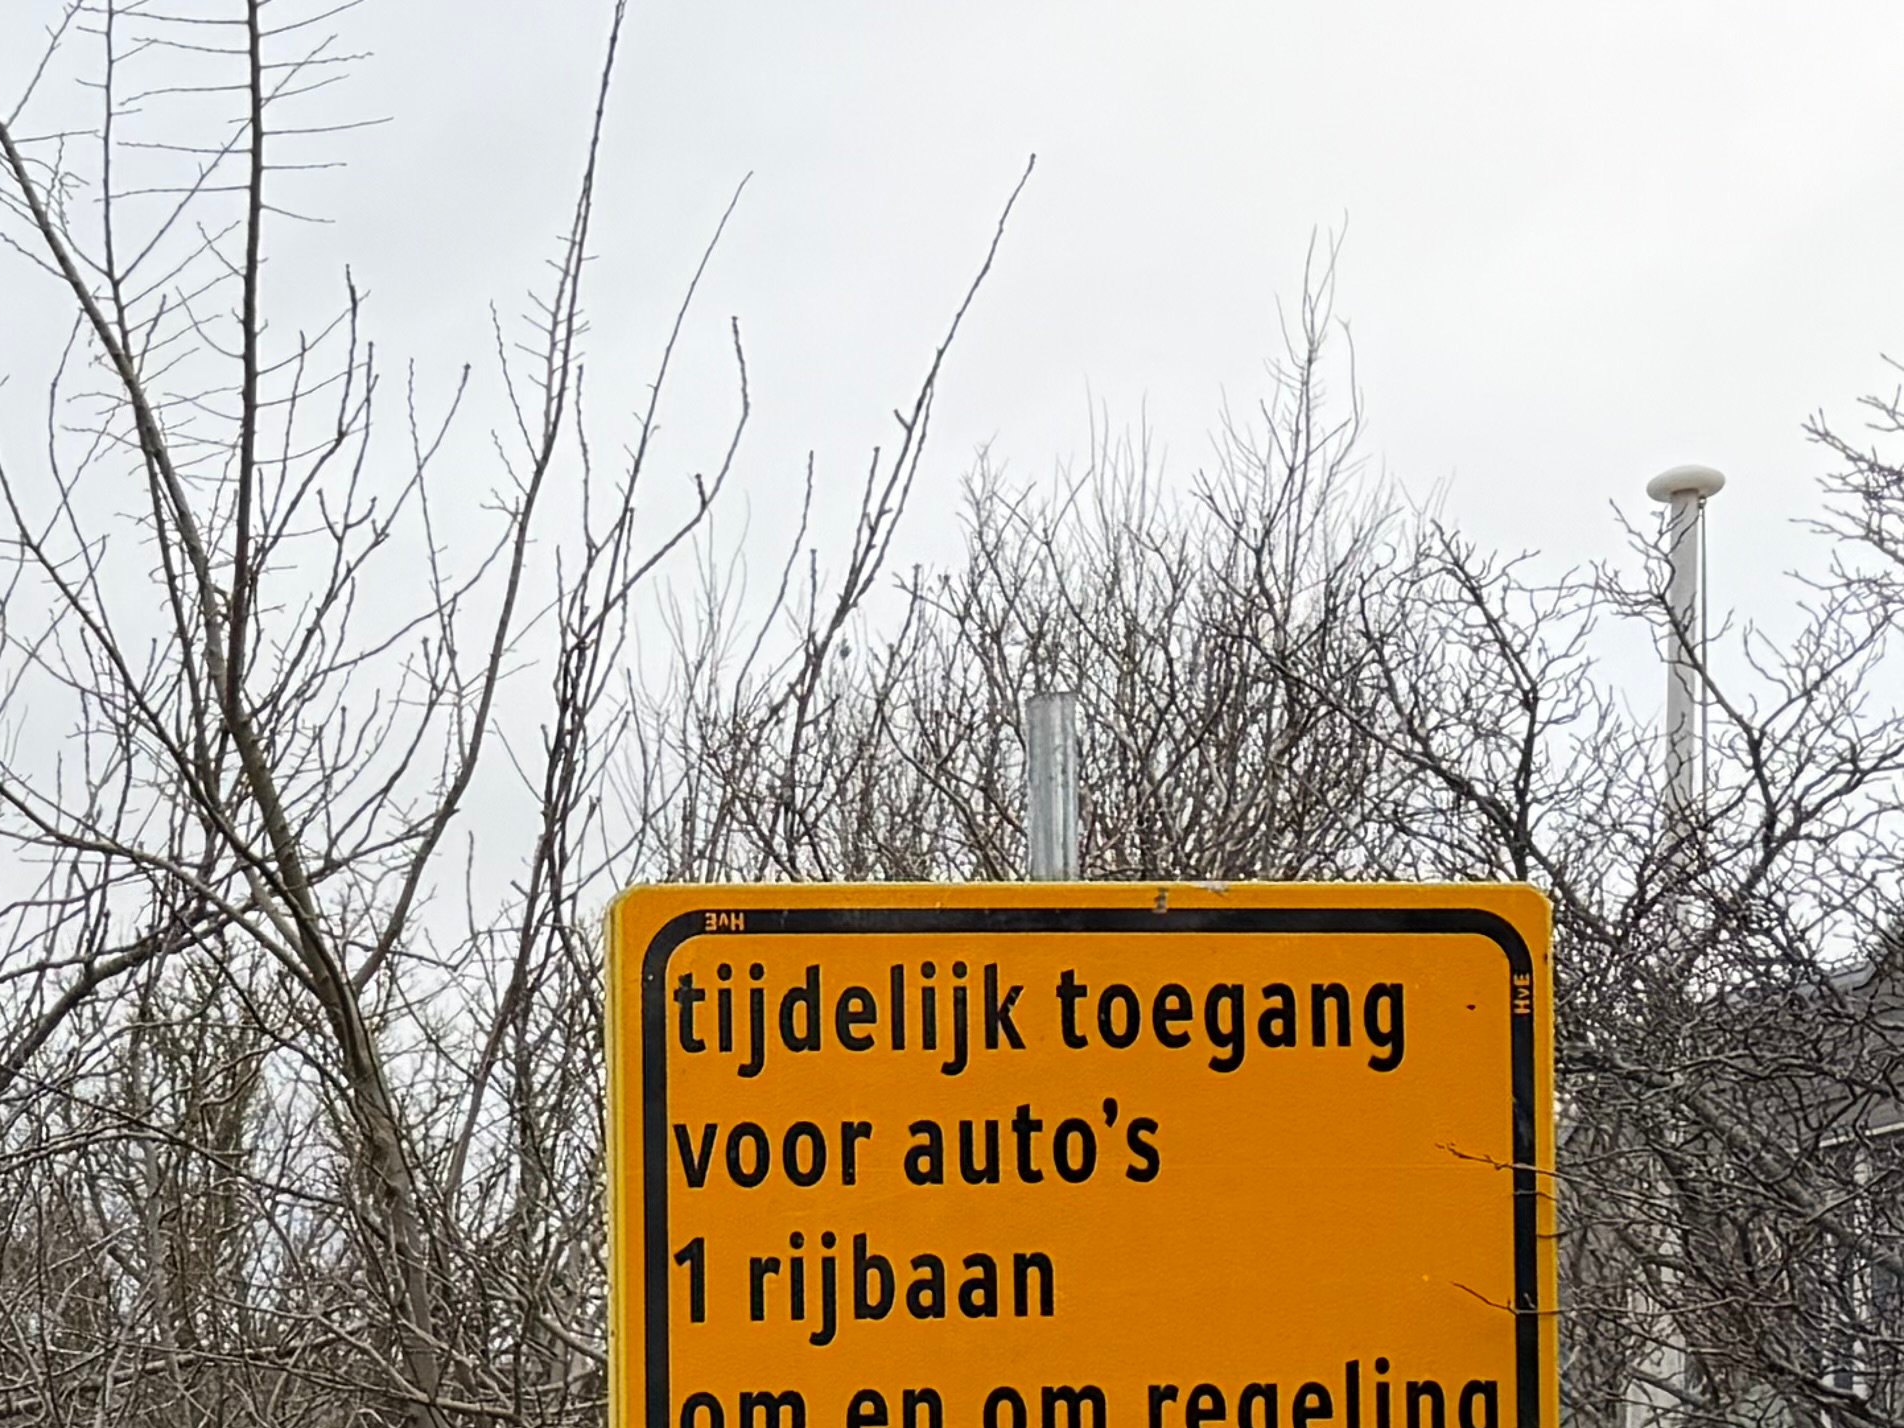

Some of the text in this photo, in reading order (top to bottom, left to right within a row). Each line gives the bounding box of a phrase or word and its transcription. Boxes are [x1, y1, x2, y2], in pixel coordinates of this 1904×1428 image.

[672, 961, 1406, 1080] tijdelijk toegang
[672, 1096, 1161, 1189] voor auto's
[672, 1230, 1055, 1348] 1 rijbaan
